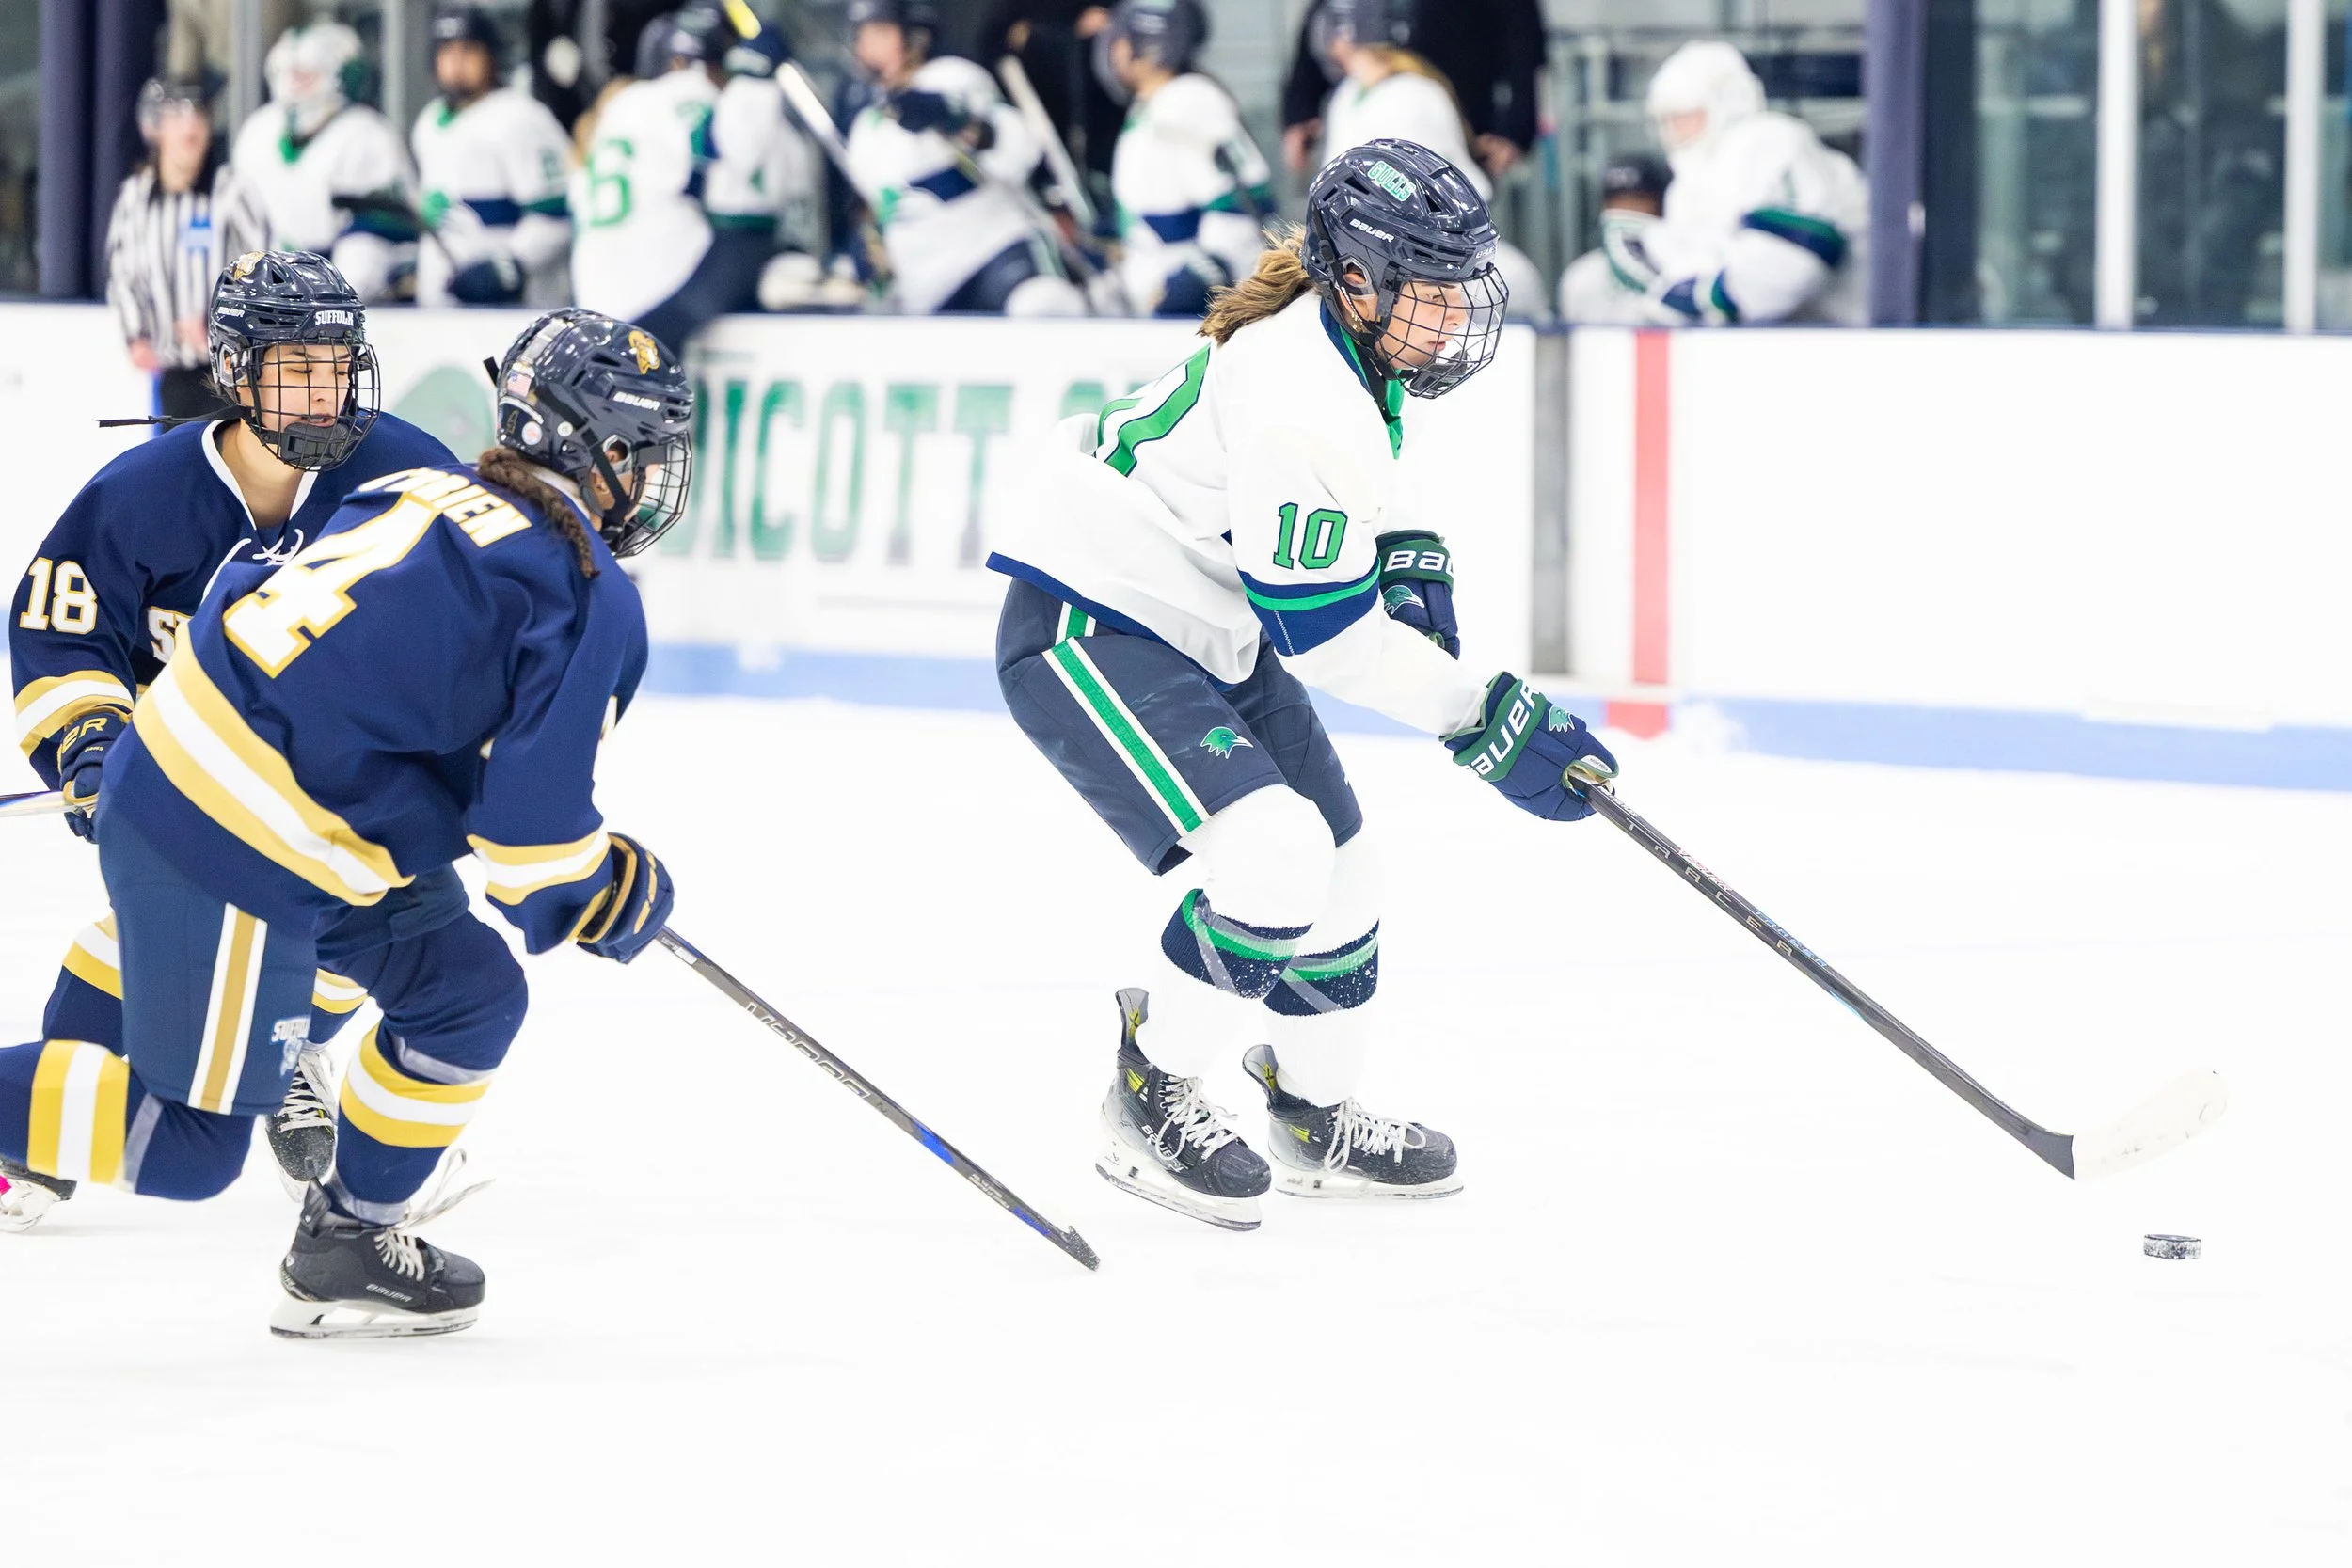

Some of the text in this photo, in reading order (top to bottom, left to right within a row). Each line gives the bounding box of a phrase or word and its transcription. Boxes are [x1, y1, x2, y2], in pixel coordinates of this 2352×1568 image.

[1349, 218, 1395, 243] BAUER
[314, 310, 354, 326] SUFFOLK
[1273, 501, 1348, 570] 10
[19, 557, 98, 635] 18
[223, 491, 445, 680] 4
[1465, 679, 1541, 778] AUER
